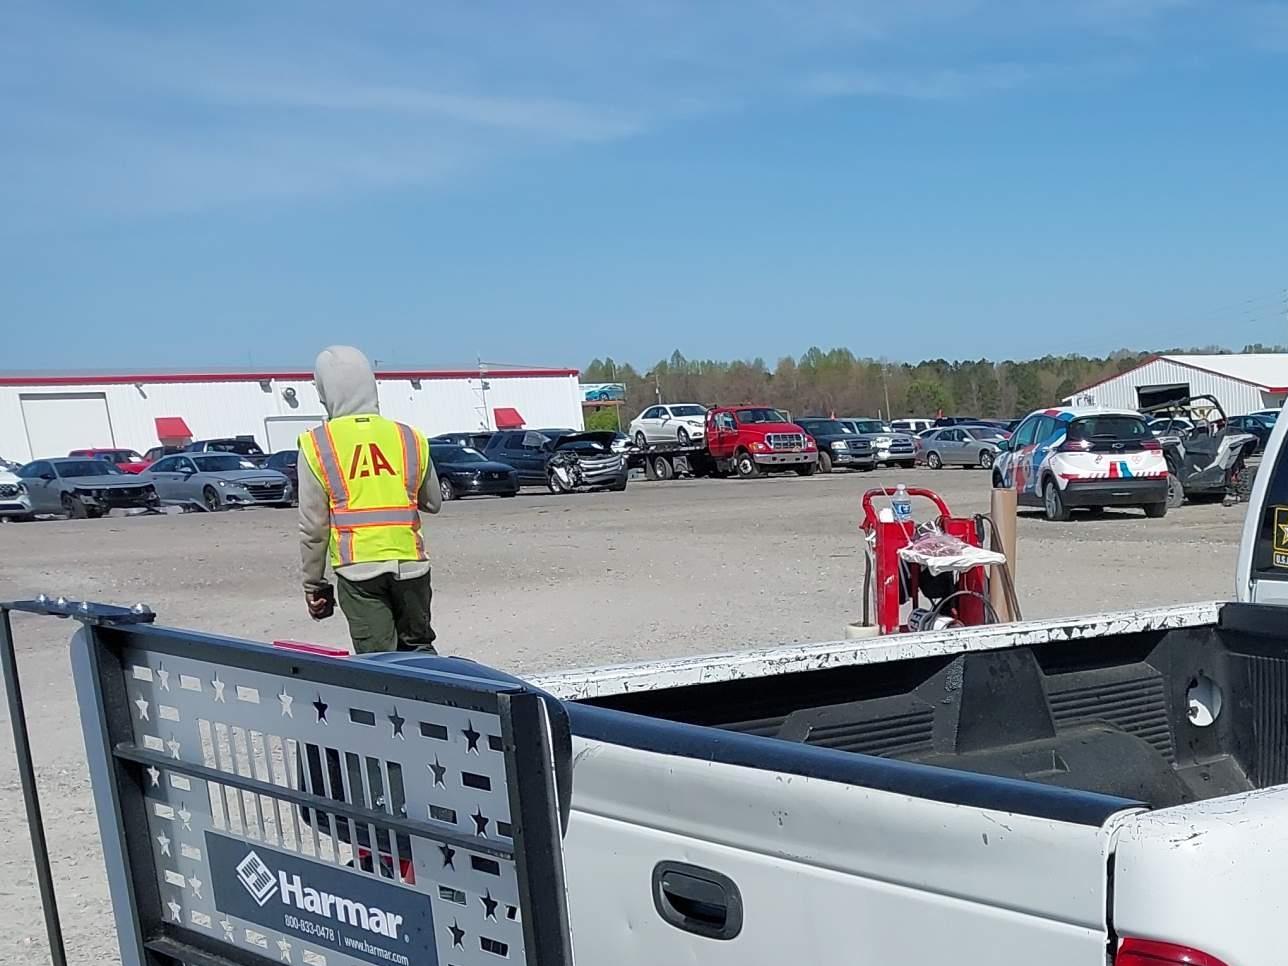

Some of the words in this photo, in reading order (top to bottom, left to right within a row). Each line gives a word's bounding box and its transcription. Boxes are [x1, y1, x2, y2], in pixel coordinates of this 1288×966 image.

[278, 870, 403, 940] Harmar
[284, 914, 335, 942] 800-833-0478
[344, 936, 409, 966] www.harmar.com
